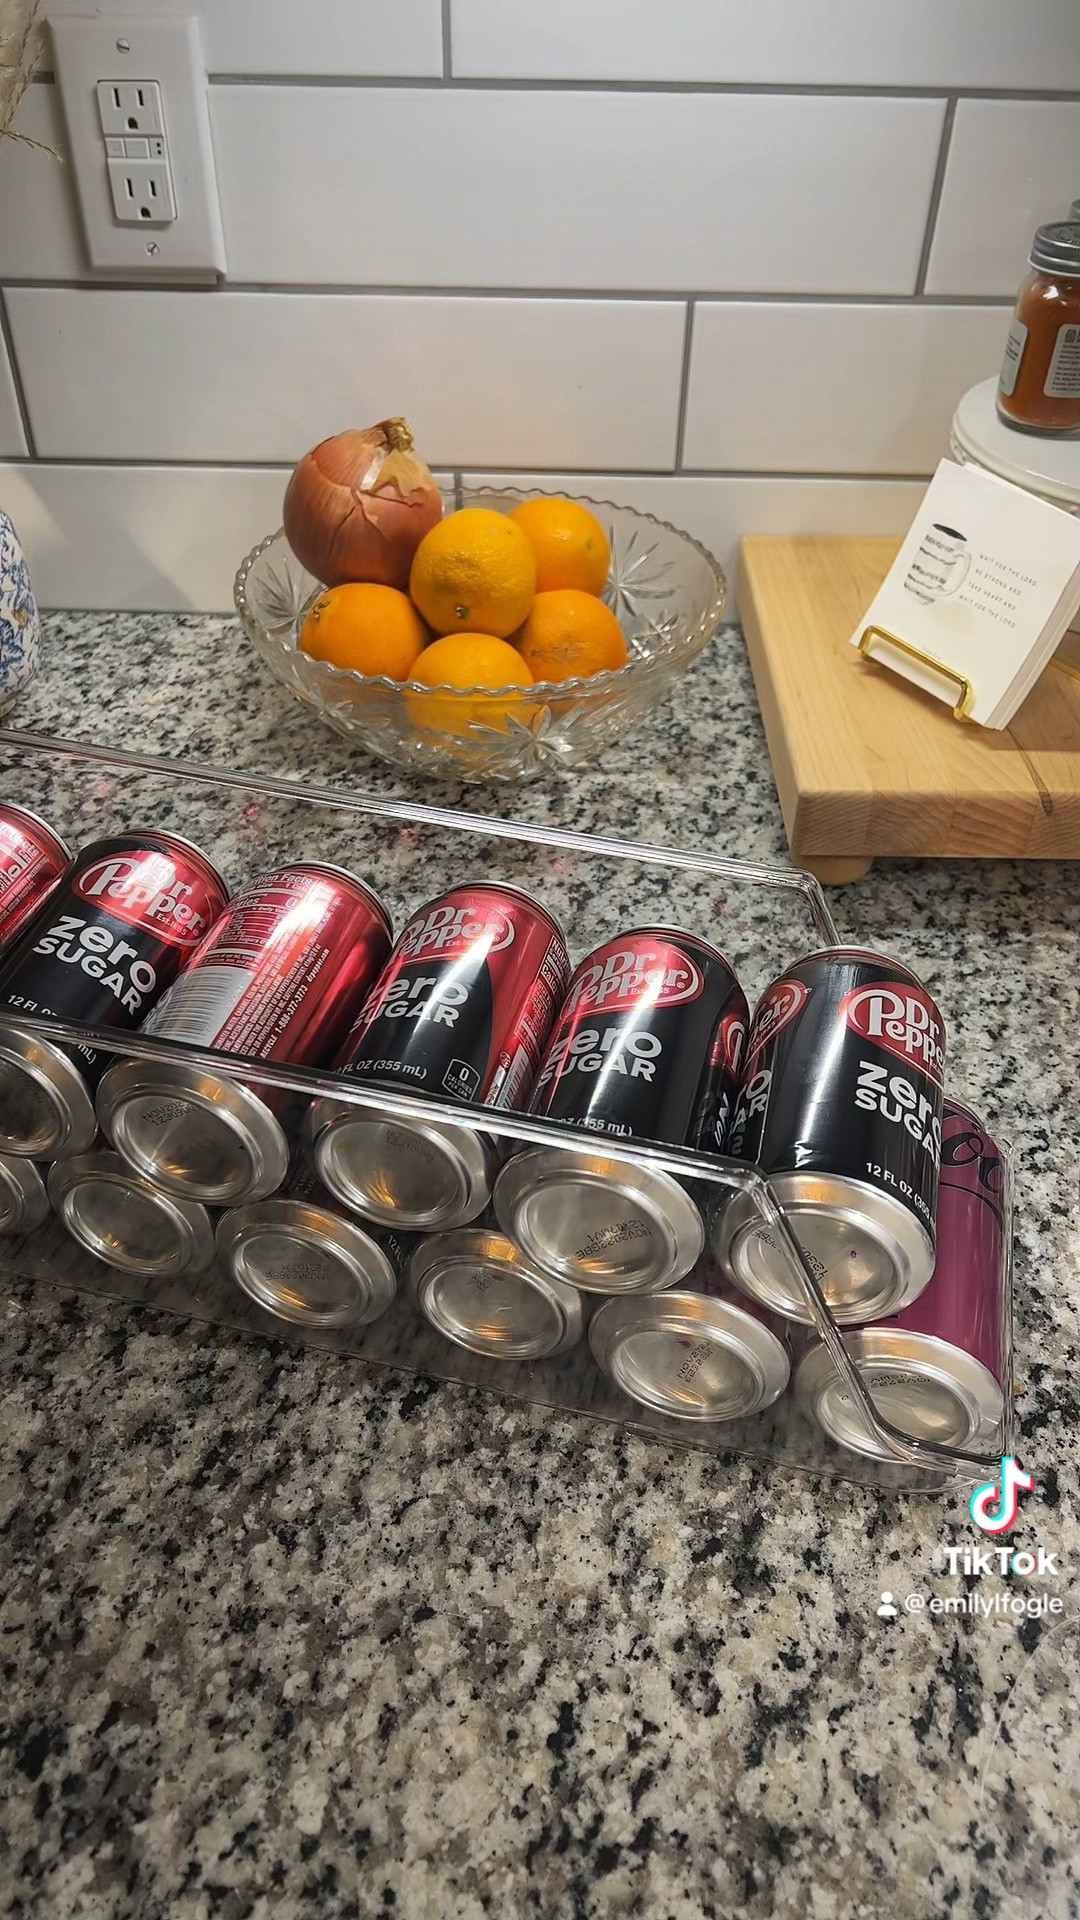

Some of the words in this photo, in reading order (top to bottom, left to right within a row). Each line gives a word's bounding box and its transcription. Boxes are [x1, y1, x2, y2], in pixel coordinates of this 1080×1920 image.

[397, 919, 505, 957] Pepper
[422, 907, 478, 933] Dr
[46, 915, 156, 993] zero
[600, 951, 657, 981] Dr
[32, 937, 142, 1016] SUGAR
[7, 994, 24, 1007] 12
[360, 977, 468, 1014] zero
[349, 1000, 460, 1034] SUGAR
[847, 989, 945, 1069] Peppe
[905, 996, 940, 1040] Dr
[546, 1026, 663, 1067] zero
[356, 1060, 374, 1070] OZ
[373, 1060, 401, 1071] (355
[402, 1064, 428, 1080] mL)
[459, 1067, 470, 1081] 0
[538, 1053, 656, 1088] SUGAR
[866, 1162, 882, 1178] 12
[883, 1170, 898, 1188] FL
[899, 1180, 913, 1199] OZ
